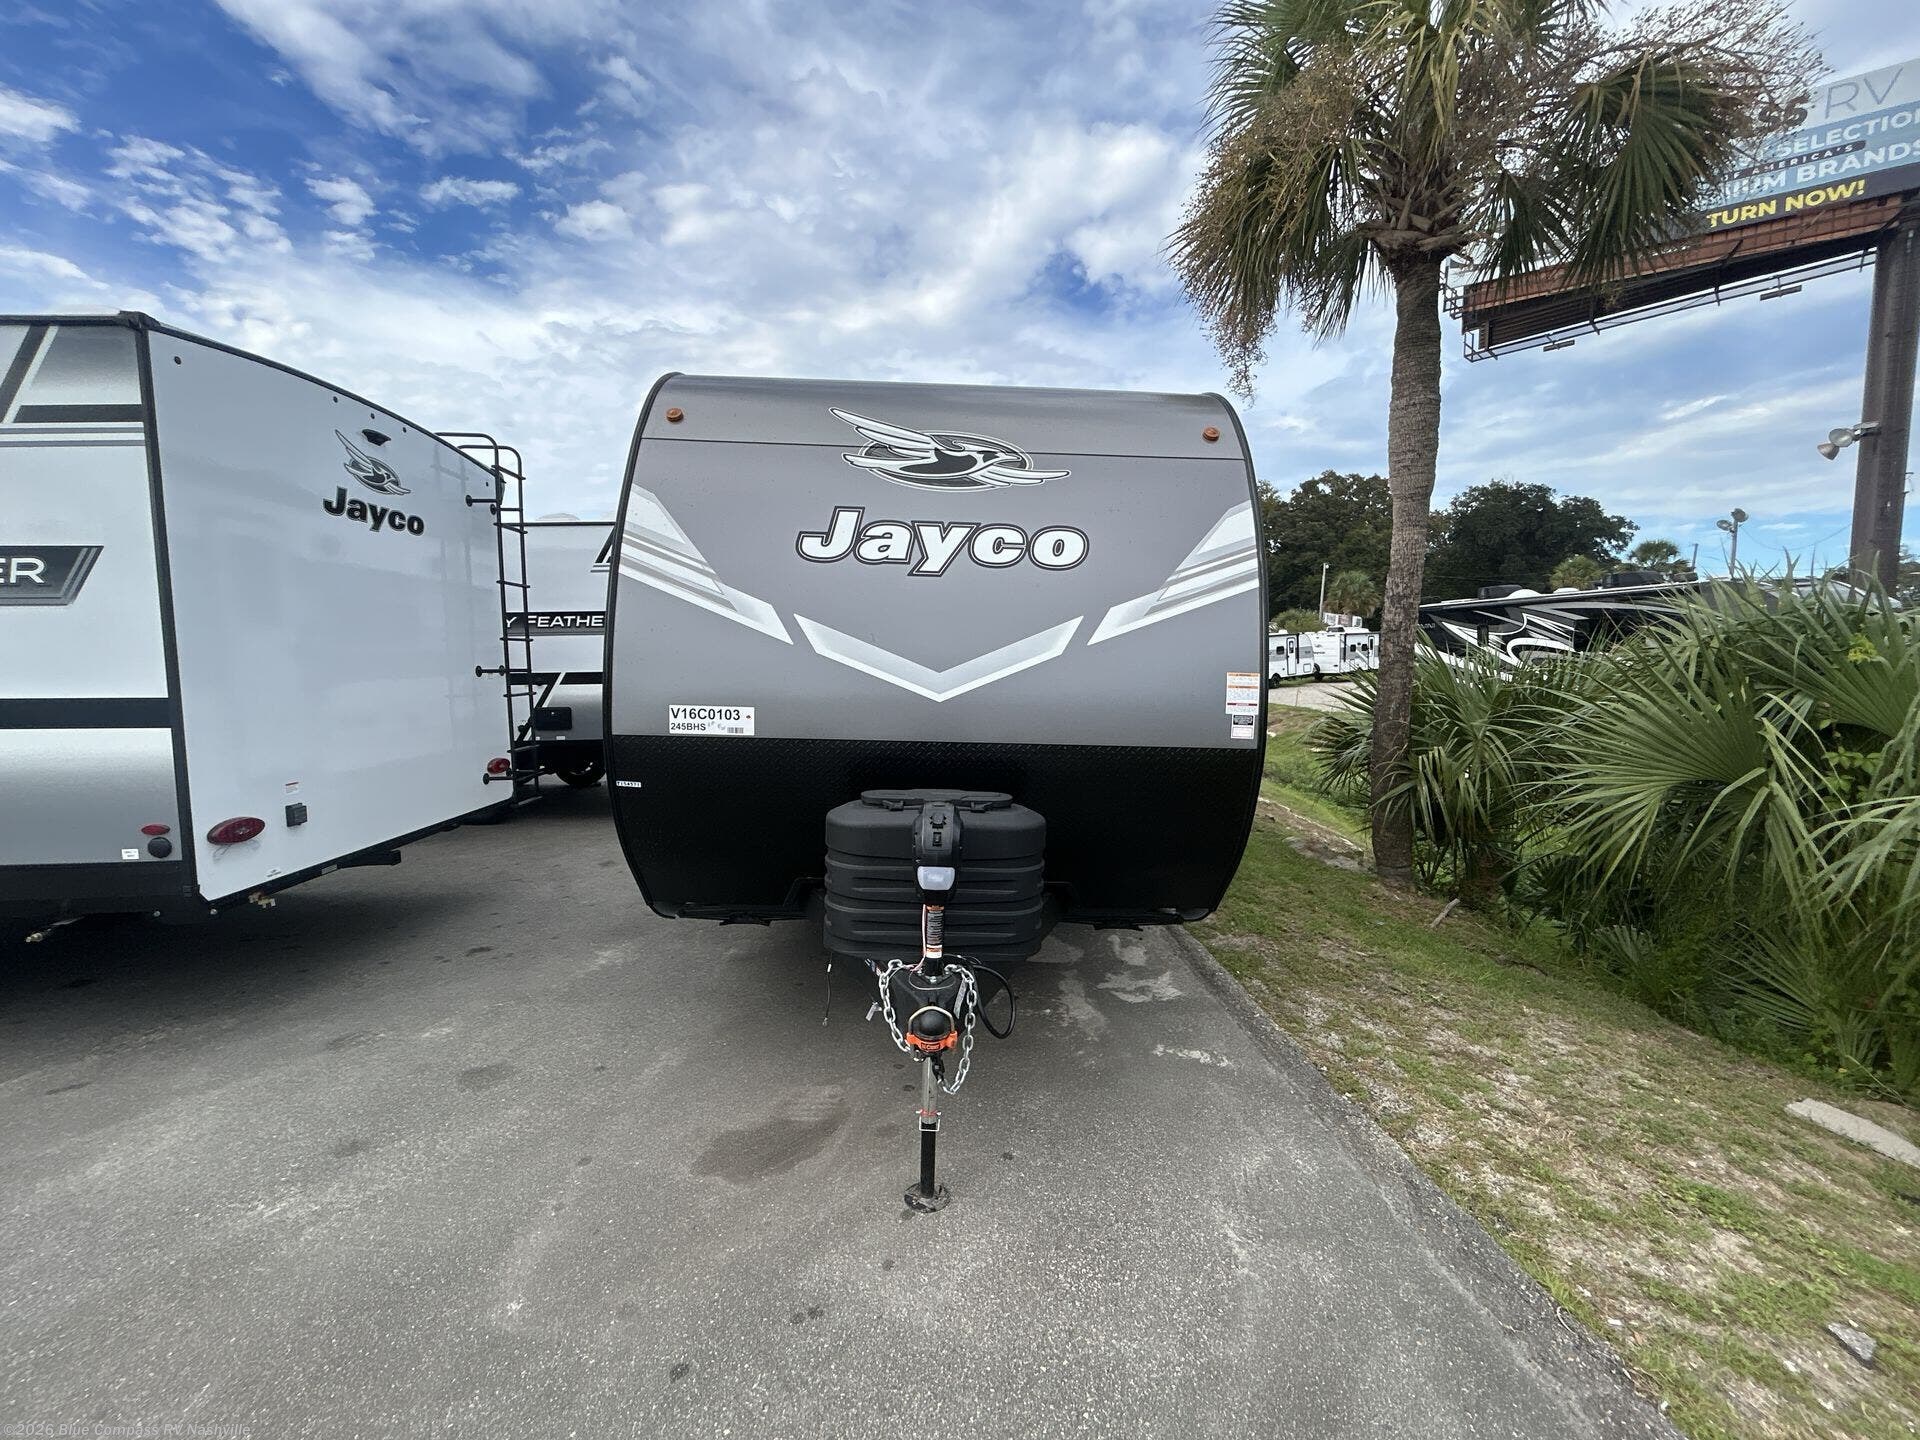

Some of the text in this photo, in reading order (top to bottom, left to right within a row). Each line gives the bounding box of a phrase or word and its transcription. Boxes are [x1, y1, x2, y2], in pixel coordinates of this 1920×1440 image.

[1825, 67, 1904, 119] RV
[1752, 143, 1854, 175] AMERICA'S
[1706, 179, 1866, 228] TURN NOW!
[323, 486, 425, 536] Jayco
[796, 506, 1090, 577] Jayco
[670, 707, 741, 721] V16C0103
[670, 722, 707, 731] 245BHS
